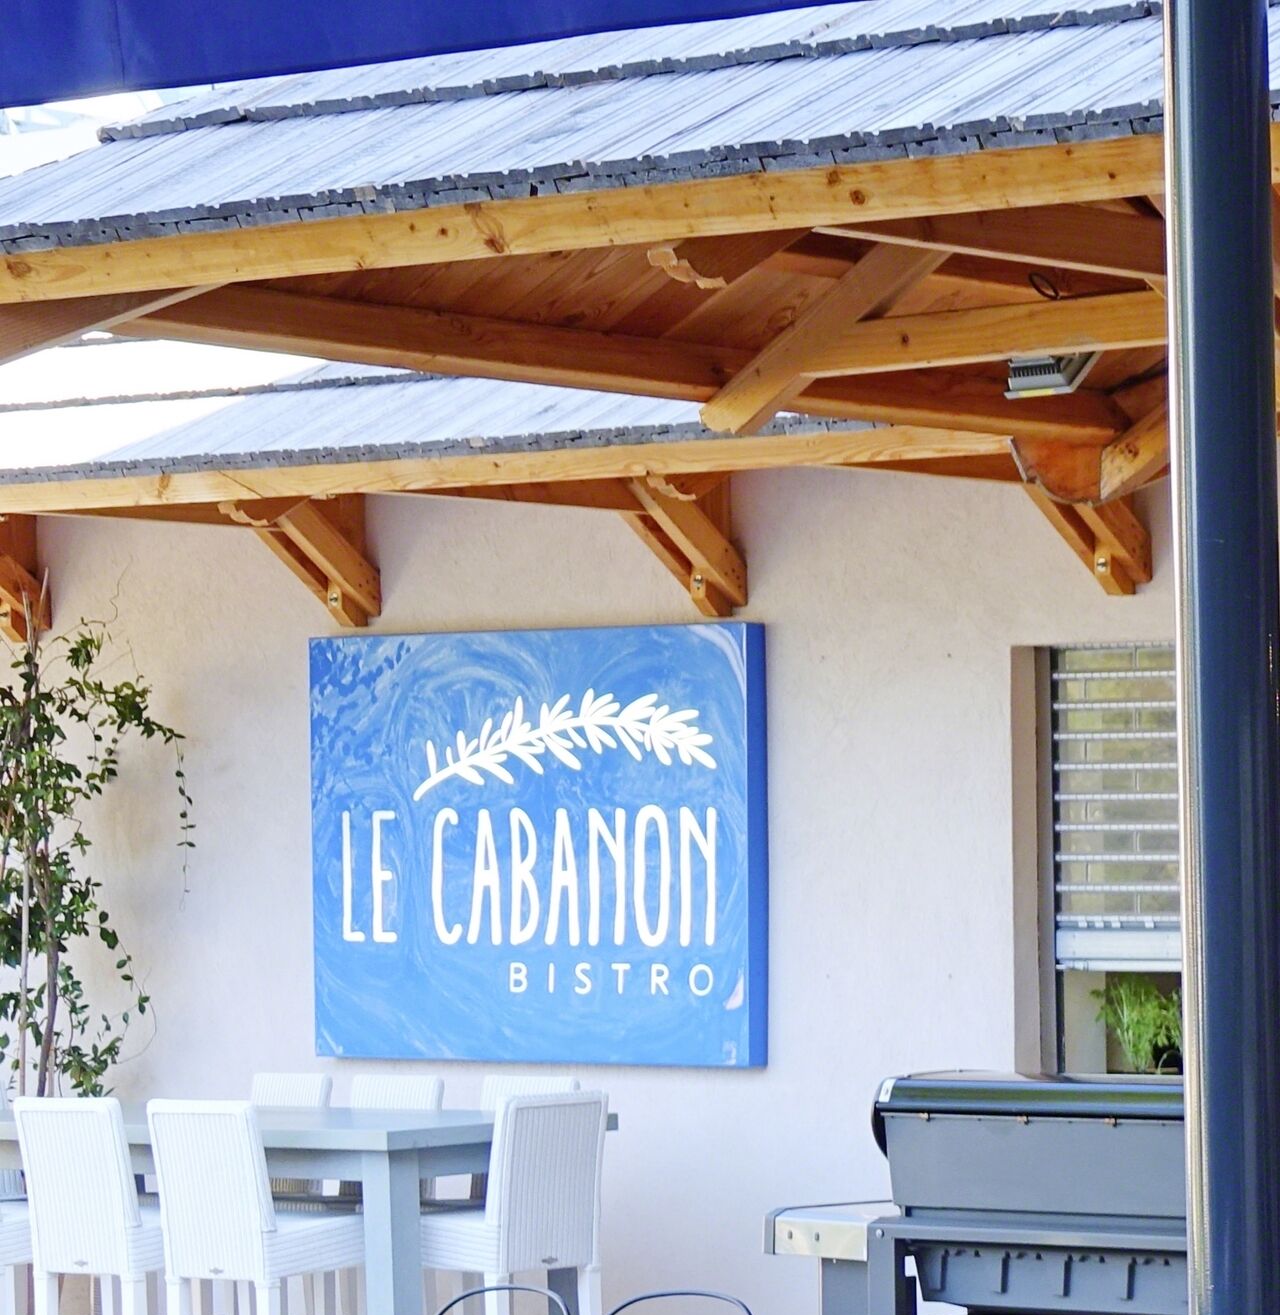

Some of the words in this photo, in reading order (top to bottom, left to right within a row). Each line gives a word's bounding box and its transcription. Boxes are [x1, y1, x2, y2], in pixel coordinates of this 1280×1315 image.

[342, 810, 398, 943] LE
[431, 804, 718, 948] CABANON
[509, 962, 714, 996] BISTRO
